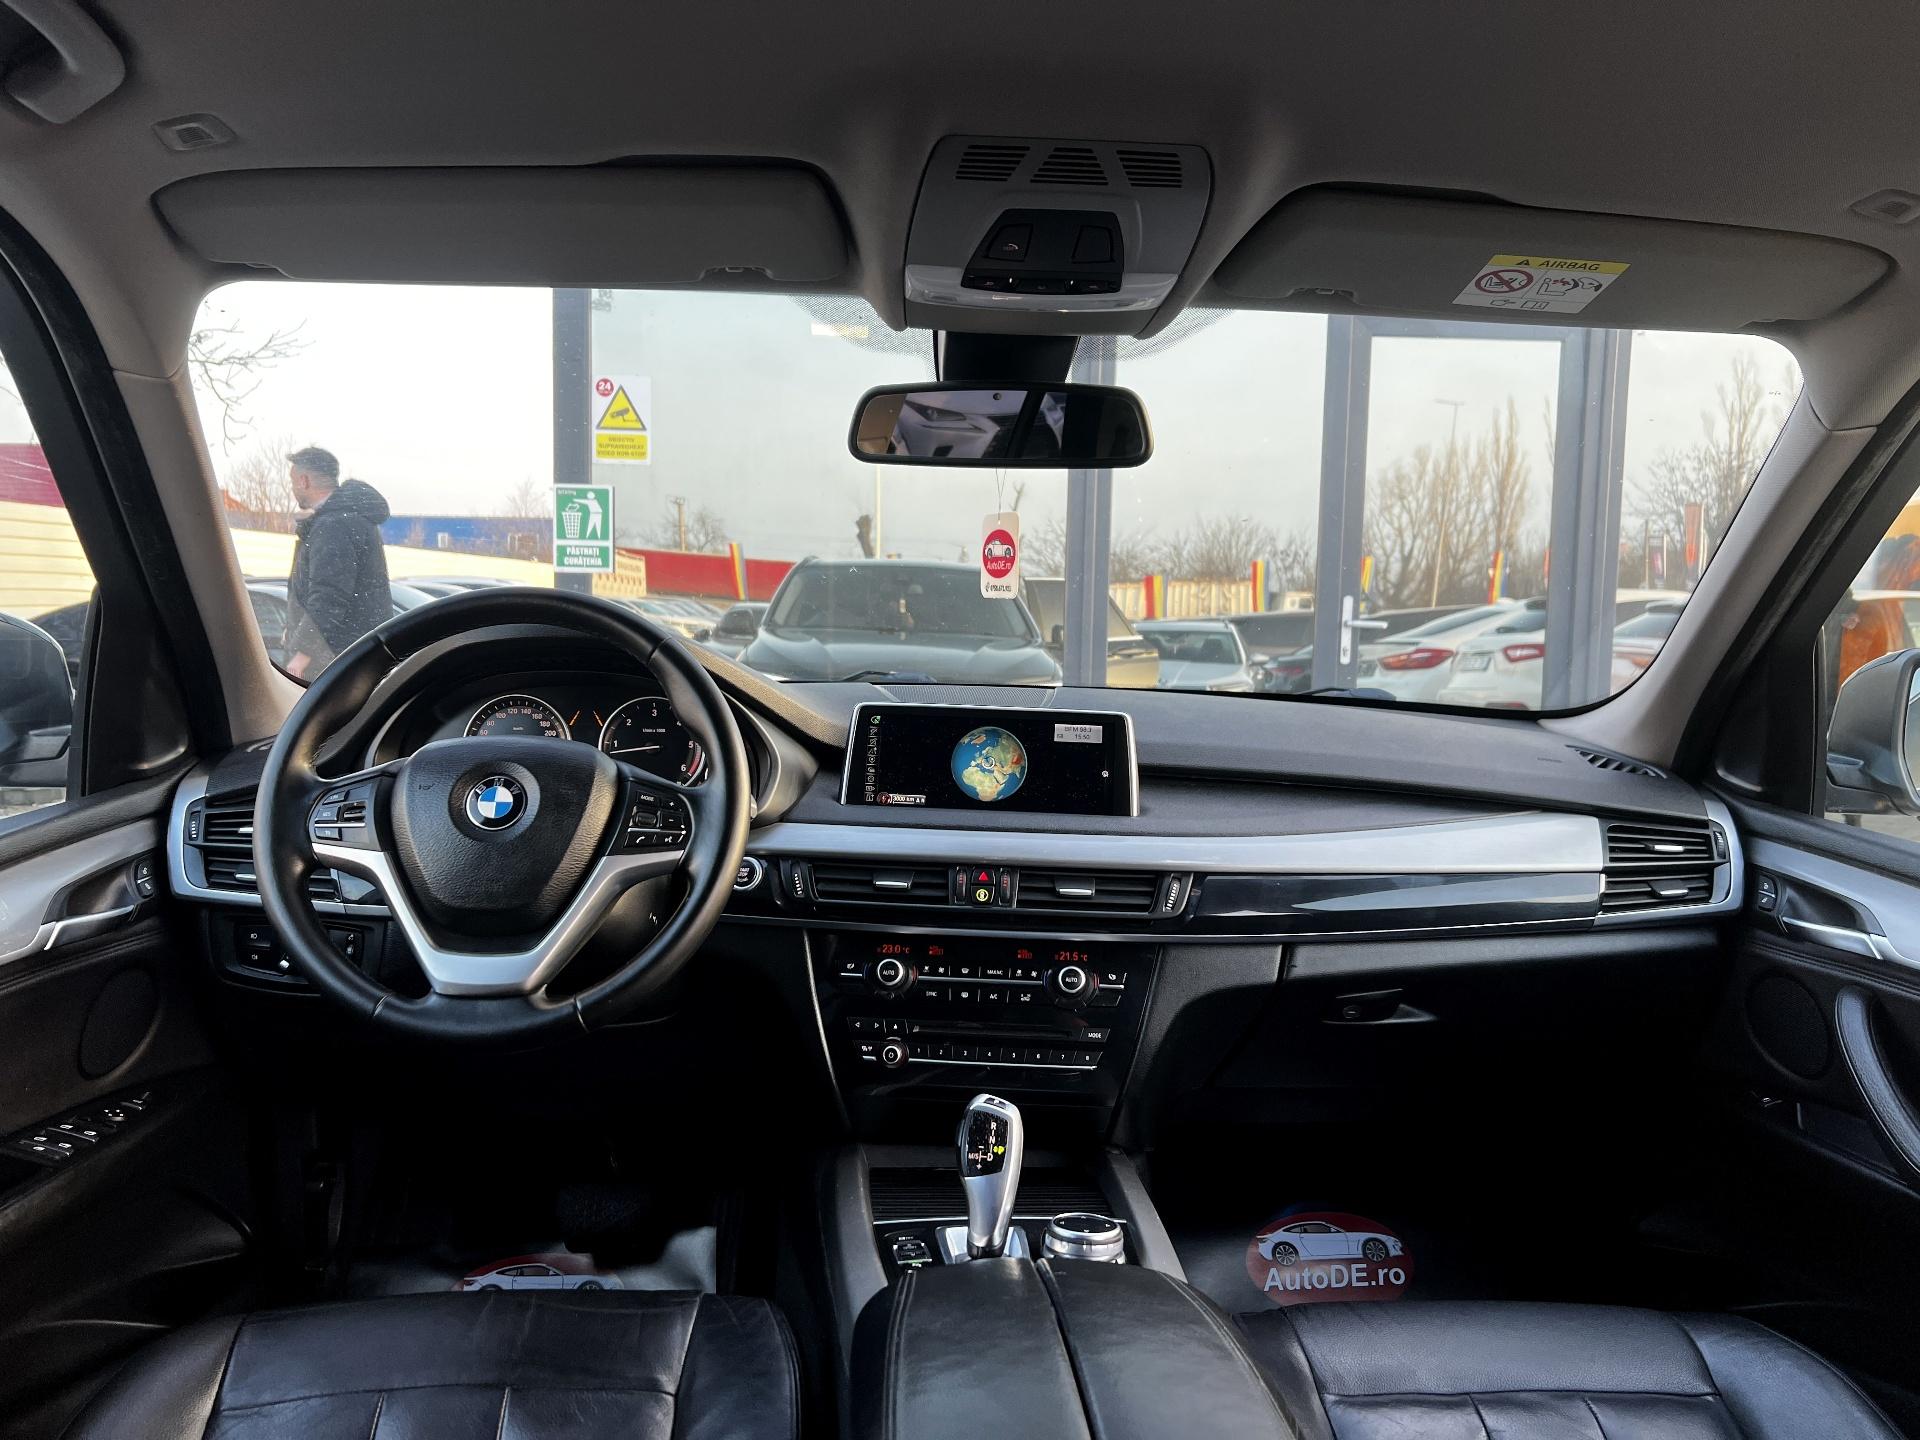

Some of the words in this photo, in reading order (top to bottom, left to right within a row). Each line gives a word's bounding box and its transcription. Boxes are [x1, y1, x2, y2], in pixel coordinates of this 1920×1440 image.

[1539, 260, 1601, 271] AIRBAG
[598, 381, 611, 391] 24
[986, 560, 1012, 570] AutoDE.ro
[651, 709, 658, 717] 3
[539, 720, 551, 728] 180
[626, 718, 632, 726] 2
[613, 740, 618, 748] 1
[688, 740, 694, 748] 5
[680, 764, 687, 772] 6
[475, 778, 521, 795] BMW
[1059, 951, 1079, 961] 21.5
[990, 1121, 997, 1130] R
[989, 1135, 996, 1145] N
[986, 1152, 994, 1162] D
[1263, 1263, 1406, 1292] AutoDE.ro
